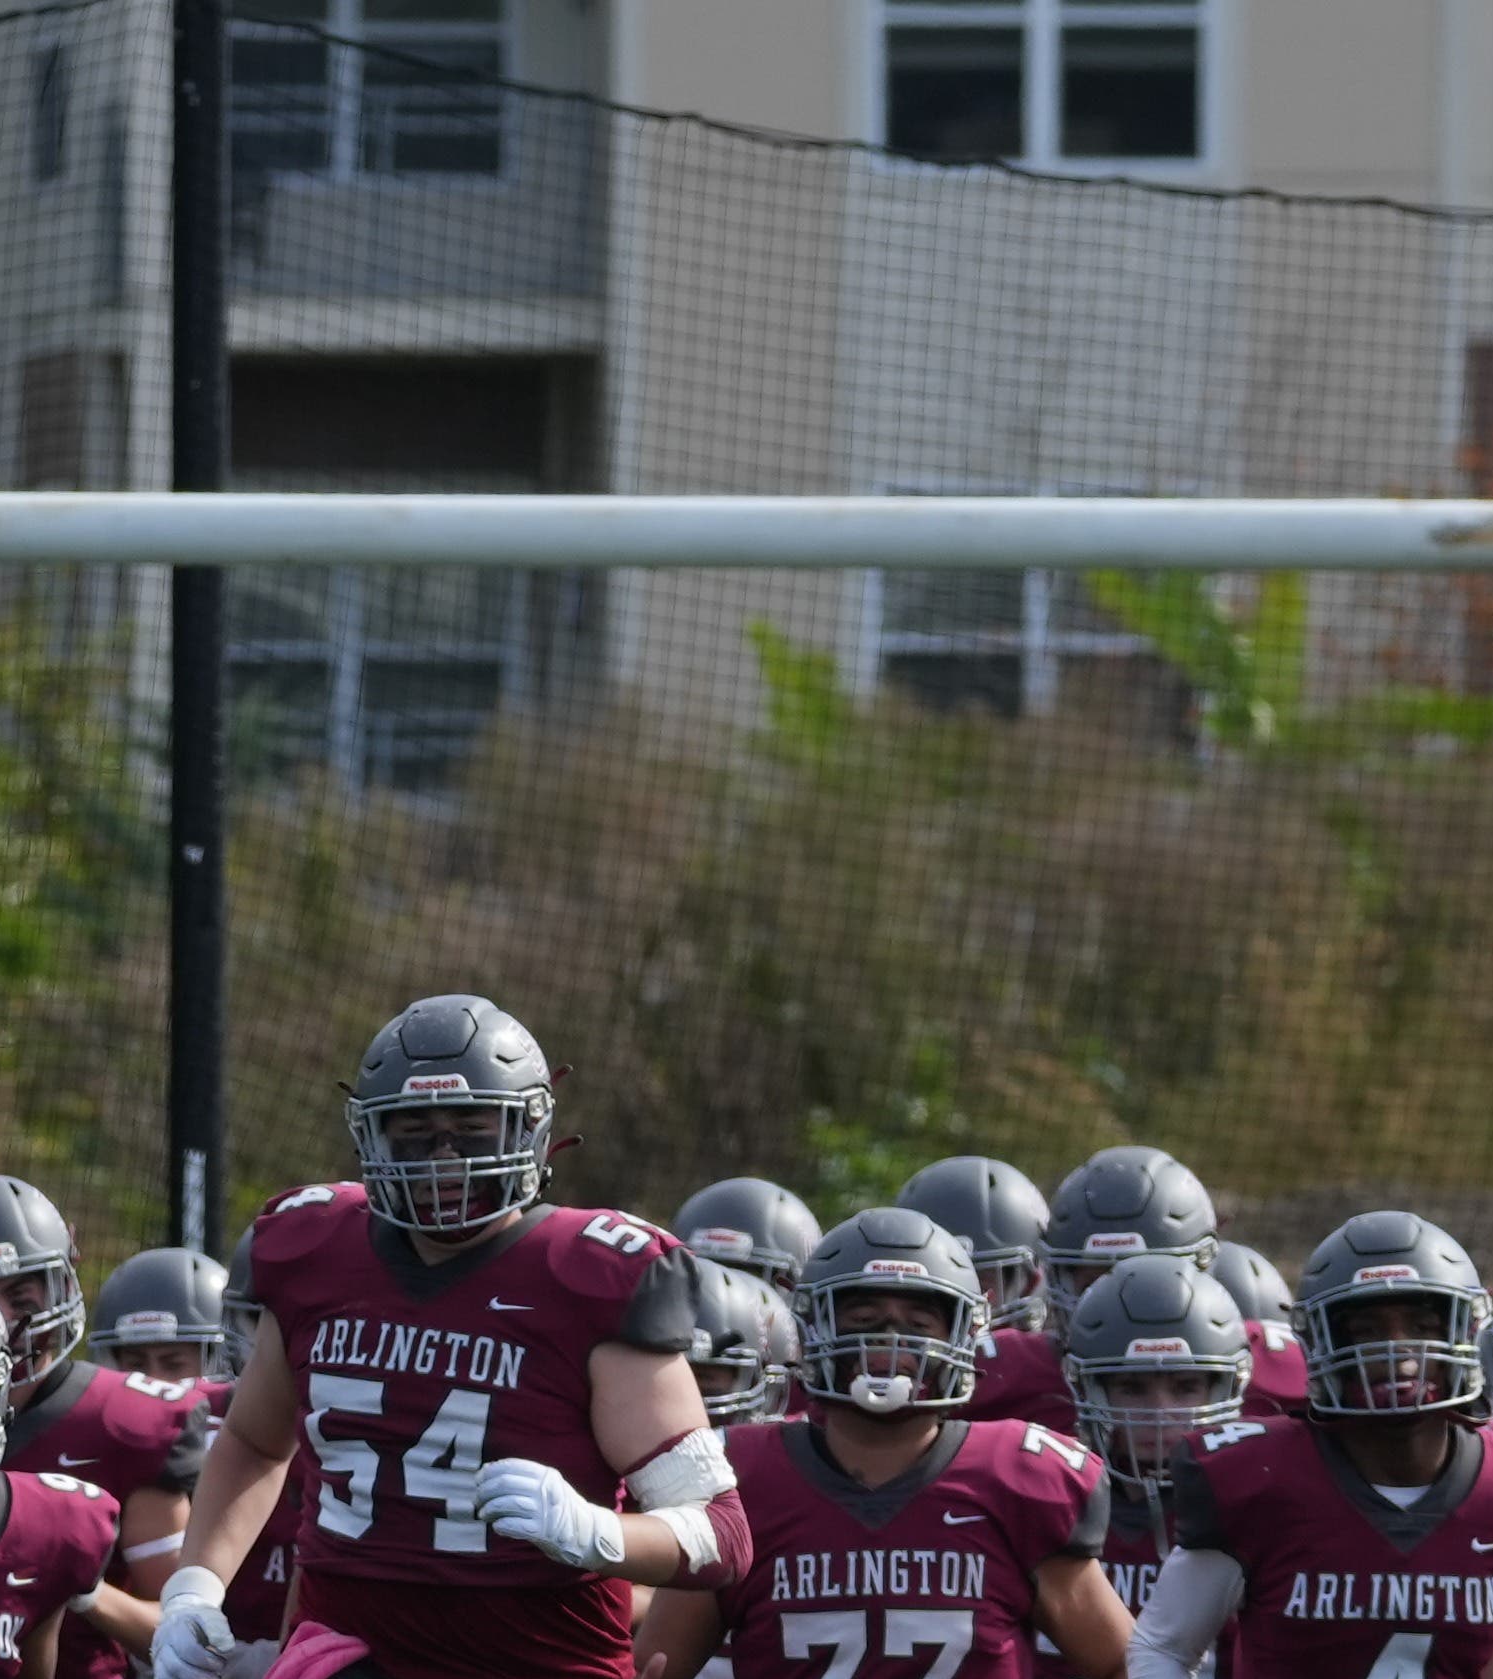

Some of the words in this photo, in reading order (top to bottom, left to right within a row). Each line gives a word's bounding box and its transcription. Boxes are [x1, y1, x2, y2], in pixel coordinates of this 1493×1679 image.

[409, 1079, 458, 1091] Riddell
[579, 1208, 680, 1256] 5
[309, 1318, 526, 1390] ARLINGTON
[304, 1372, 492, 1553] 54
[1022, 1422, 1092, 1472] 7
[771, 1549, 986, 1601] ARLINGTON
